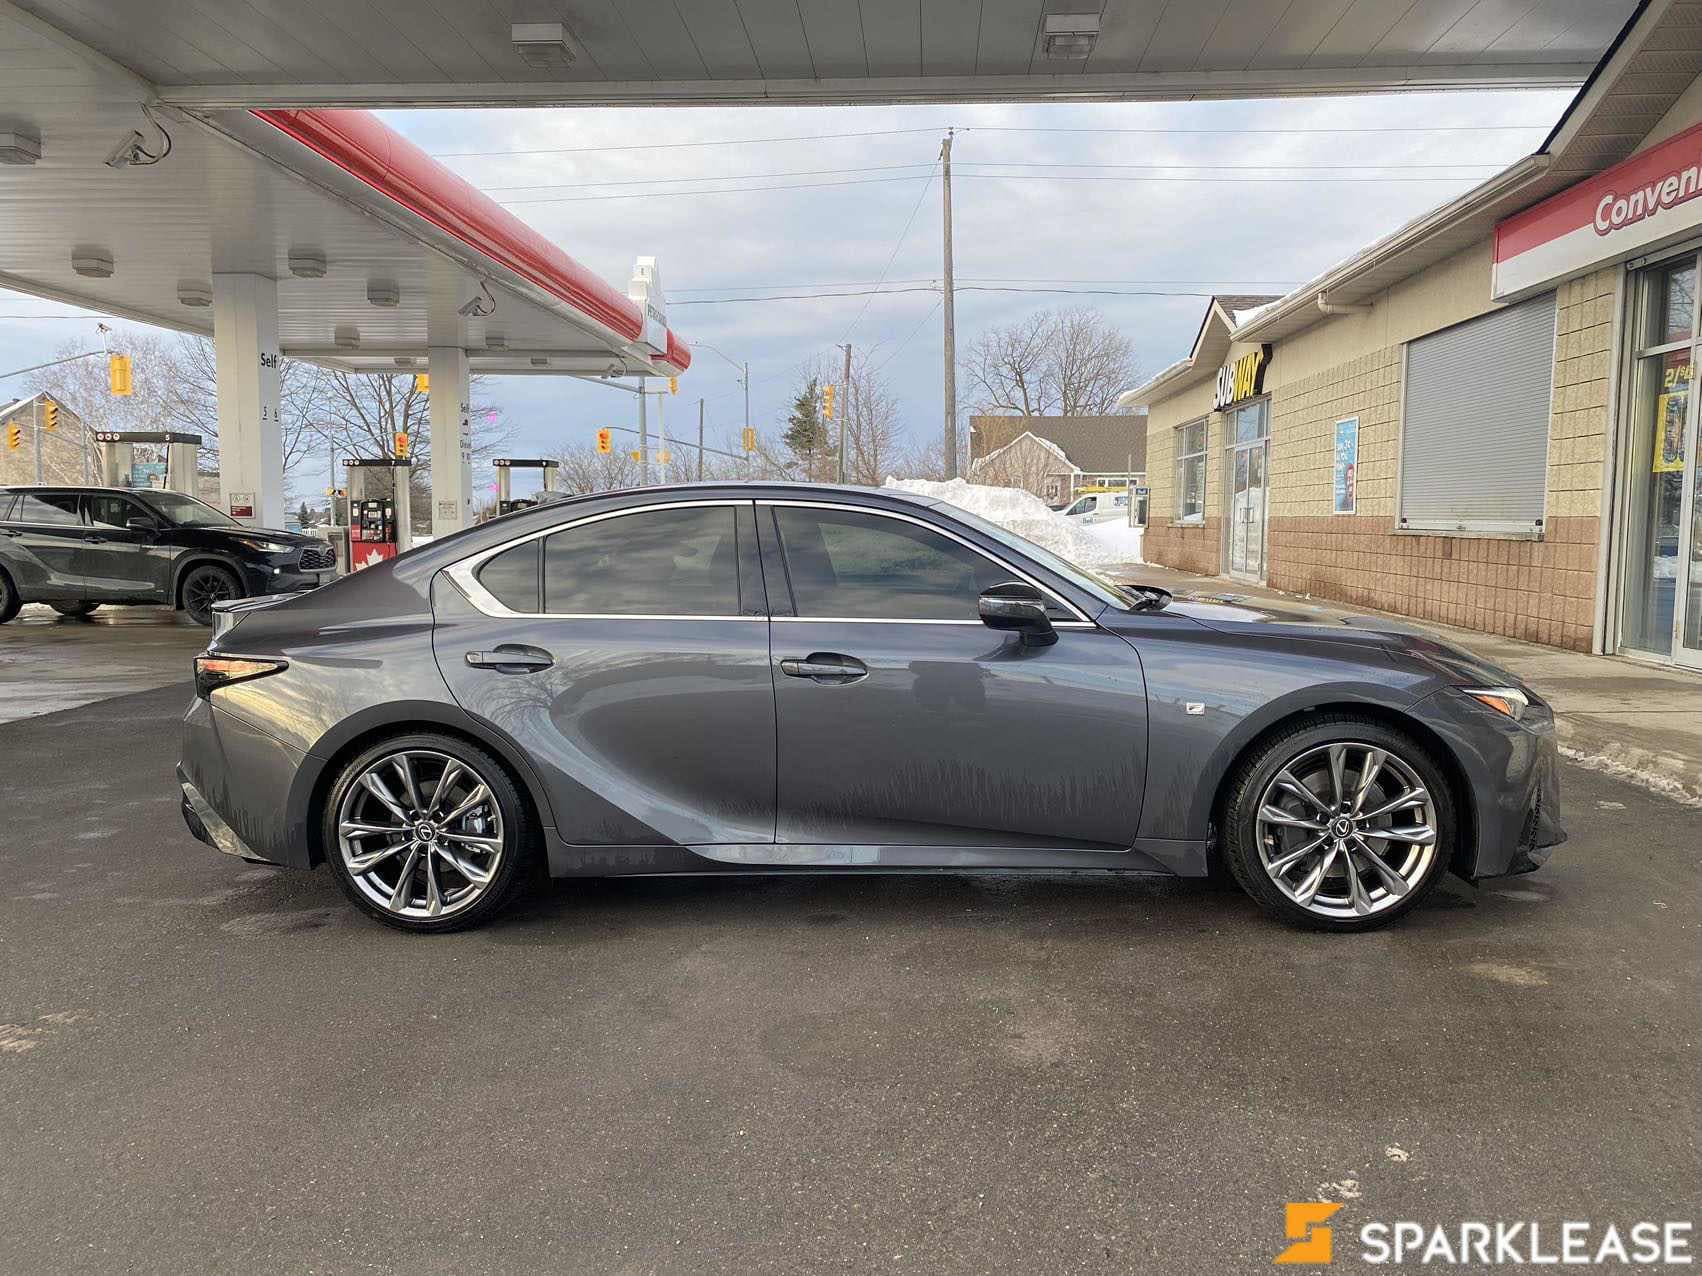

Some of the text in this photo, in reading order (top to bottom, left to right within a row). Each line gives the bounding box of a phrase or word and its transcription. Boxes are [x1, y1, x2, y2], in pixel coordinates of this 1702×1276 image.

[1594, 165, 1702, 232] Conven
[260, 352, 277, 368] Self
[1213, 350, 1265, 410] SUBWAY
